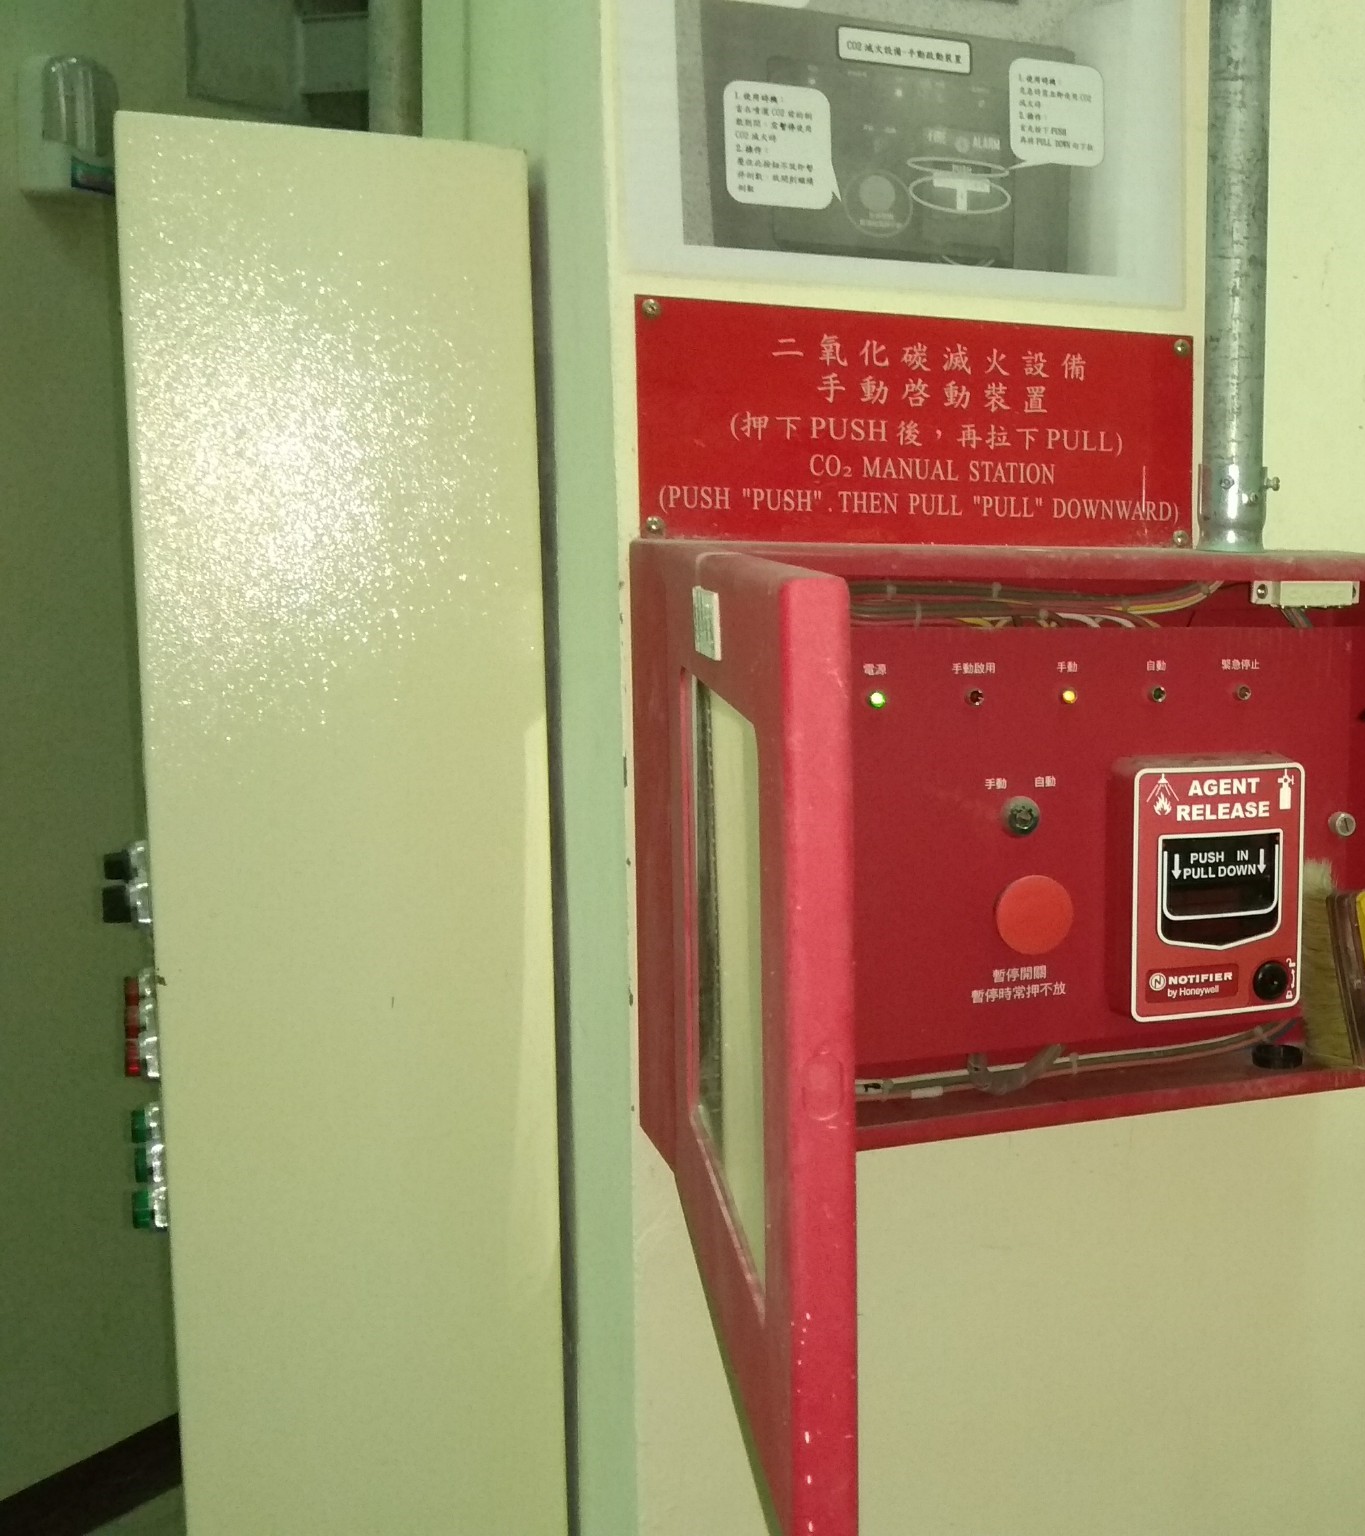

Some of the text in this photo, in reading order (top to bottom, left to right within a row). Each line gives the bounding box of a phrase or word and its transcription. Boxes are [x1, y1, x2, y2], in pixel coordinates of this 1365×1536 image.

[772, 333, 1087, 382] 二氧化碳滅火設備
[862, 456, 959, 482] MANUAL
[969, 459, 1055, 485] STATION
[659, 485, 731, 513] (PUSH
[908, 493, 963, 517] PULL
[973, 496, 1043, 519] "PULL"
[1052, 497, 1179, 526] DOWNWARD)
[863, 663, 887, 676] 電源
[1057, 661, 1078, 673] 手動
[1146, 659, 1167, 672] 自動
[1221, 658, 1260, 671] 緊急停止
[984, 777, 1007, 790] 手動
[1034, 775, 1056, 788] 自動
[1188, 777, 1260, 797] AGENT
[1176, 801, 1270, 822] RELEASE
[1190, 849, 1249, 865] PUSH IN
[1183, 863, 1257, 880] PULL DOWN
[992, 964, 1047, 983] 暫停開關
[1168, 971, 1233, 986] NOTIFIER
[971, 981, 1067, 1004] 暫停時常押不放
[1167, 984, 1220, 999] by Honeywell
